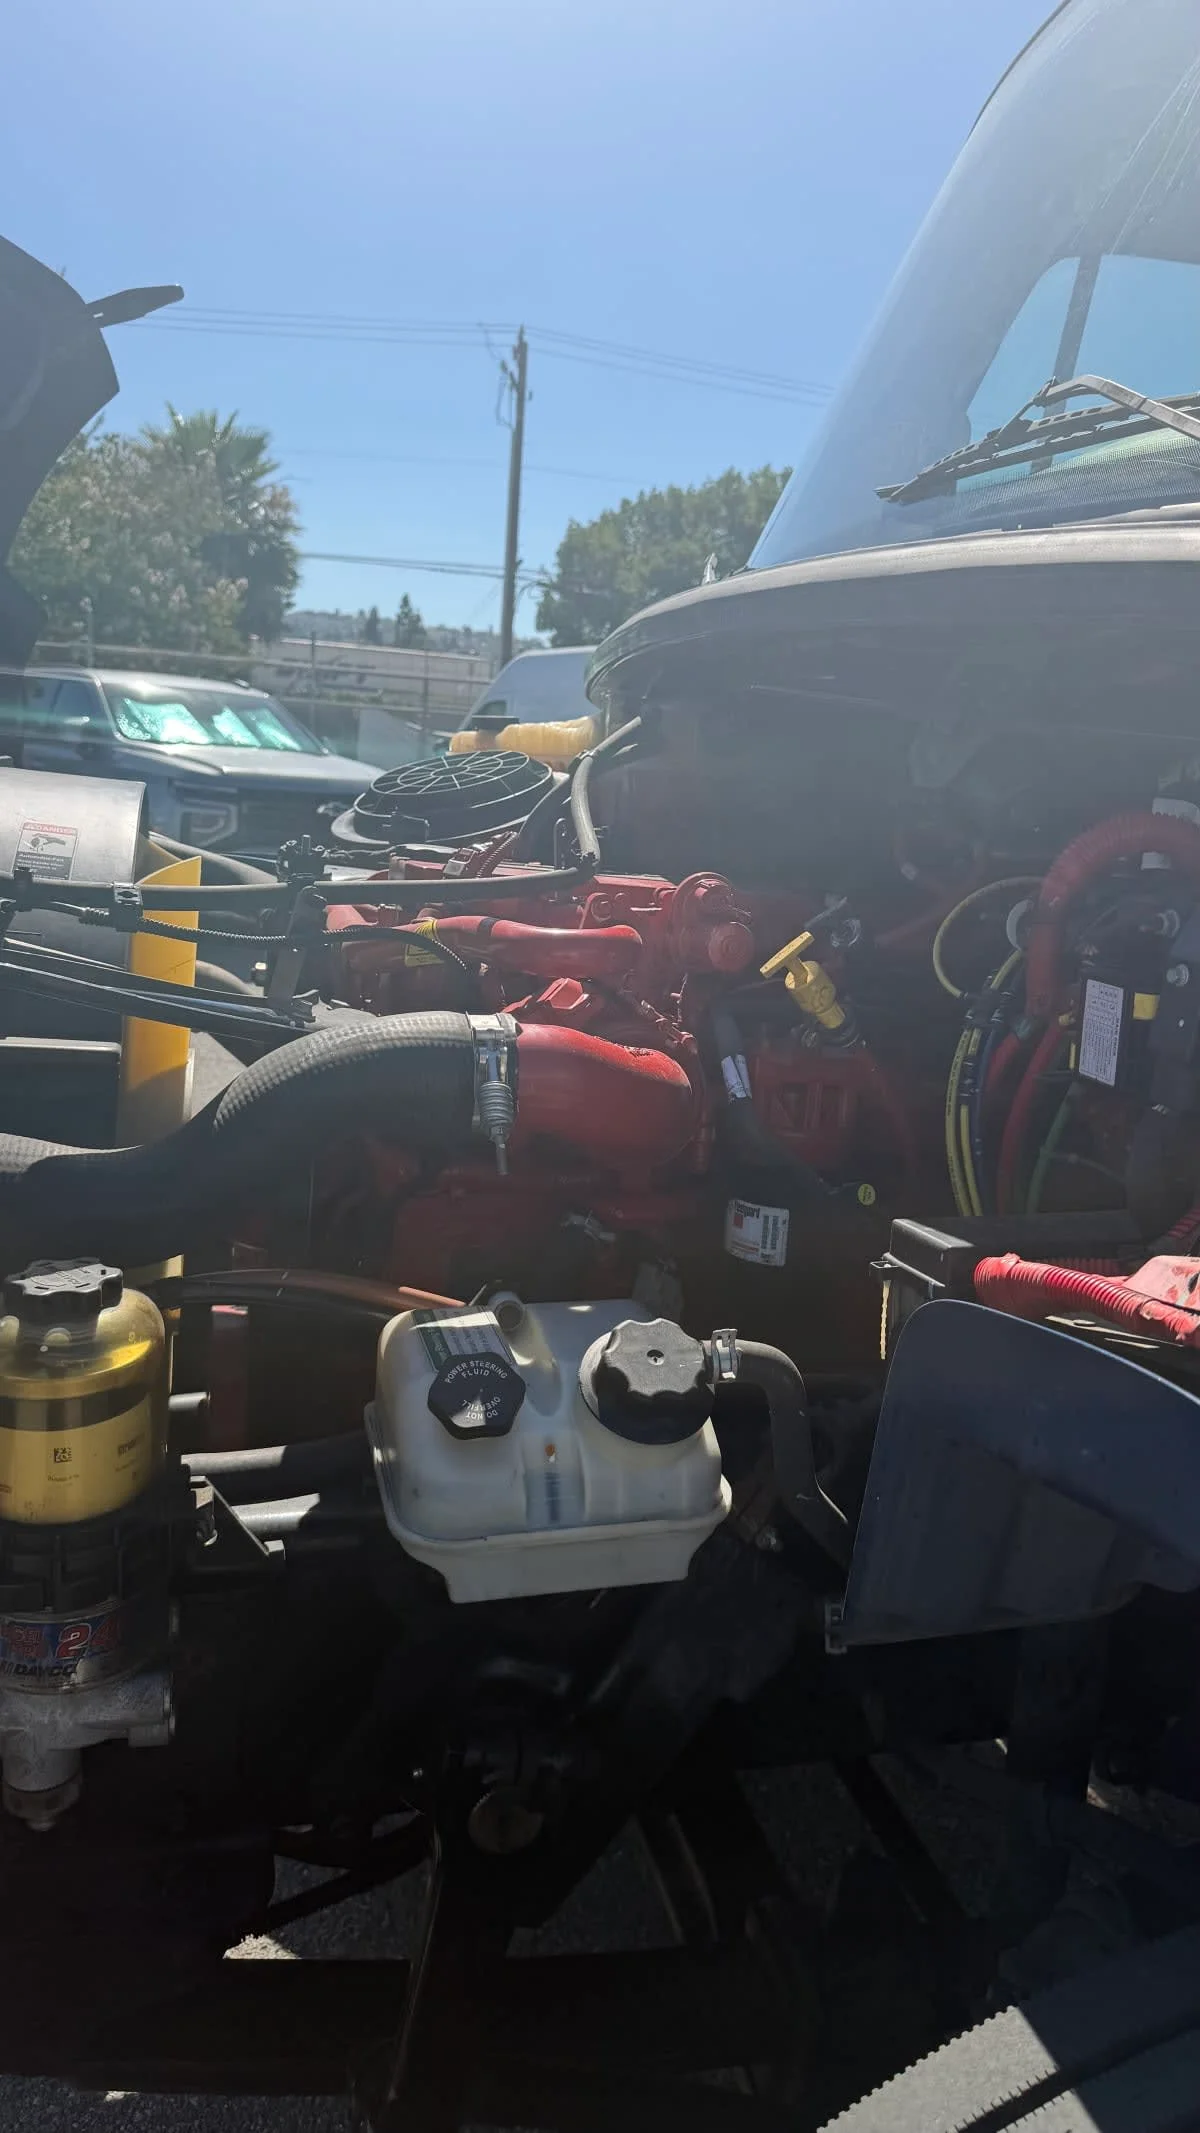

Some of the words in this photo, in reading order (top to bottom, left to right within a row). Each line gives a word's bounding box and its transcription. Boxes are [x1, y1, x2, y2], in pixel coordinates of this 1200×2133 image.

[446, 1363, 468, 1383] POWER
[470, 1361, 507, 1379] STEERING
[462, 1369, 489, 1378] FLUID
[462, 1397, 500, 1411] OVERFILL
[466, 1412, 483, 1420] NOT
[487, 1409, 498, 1418] DO
